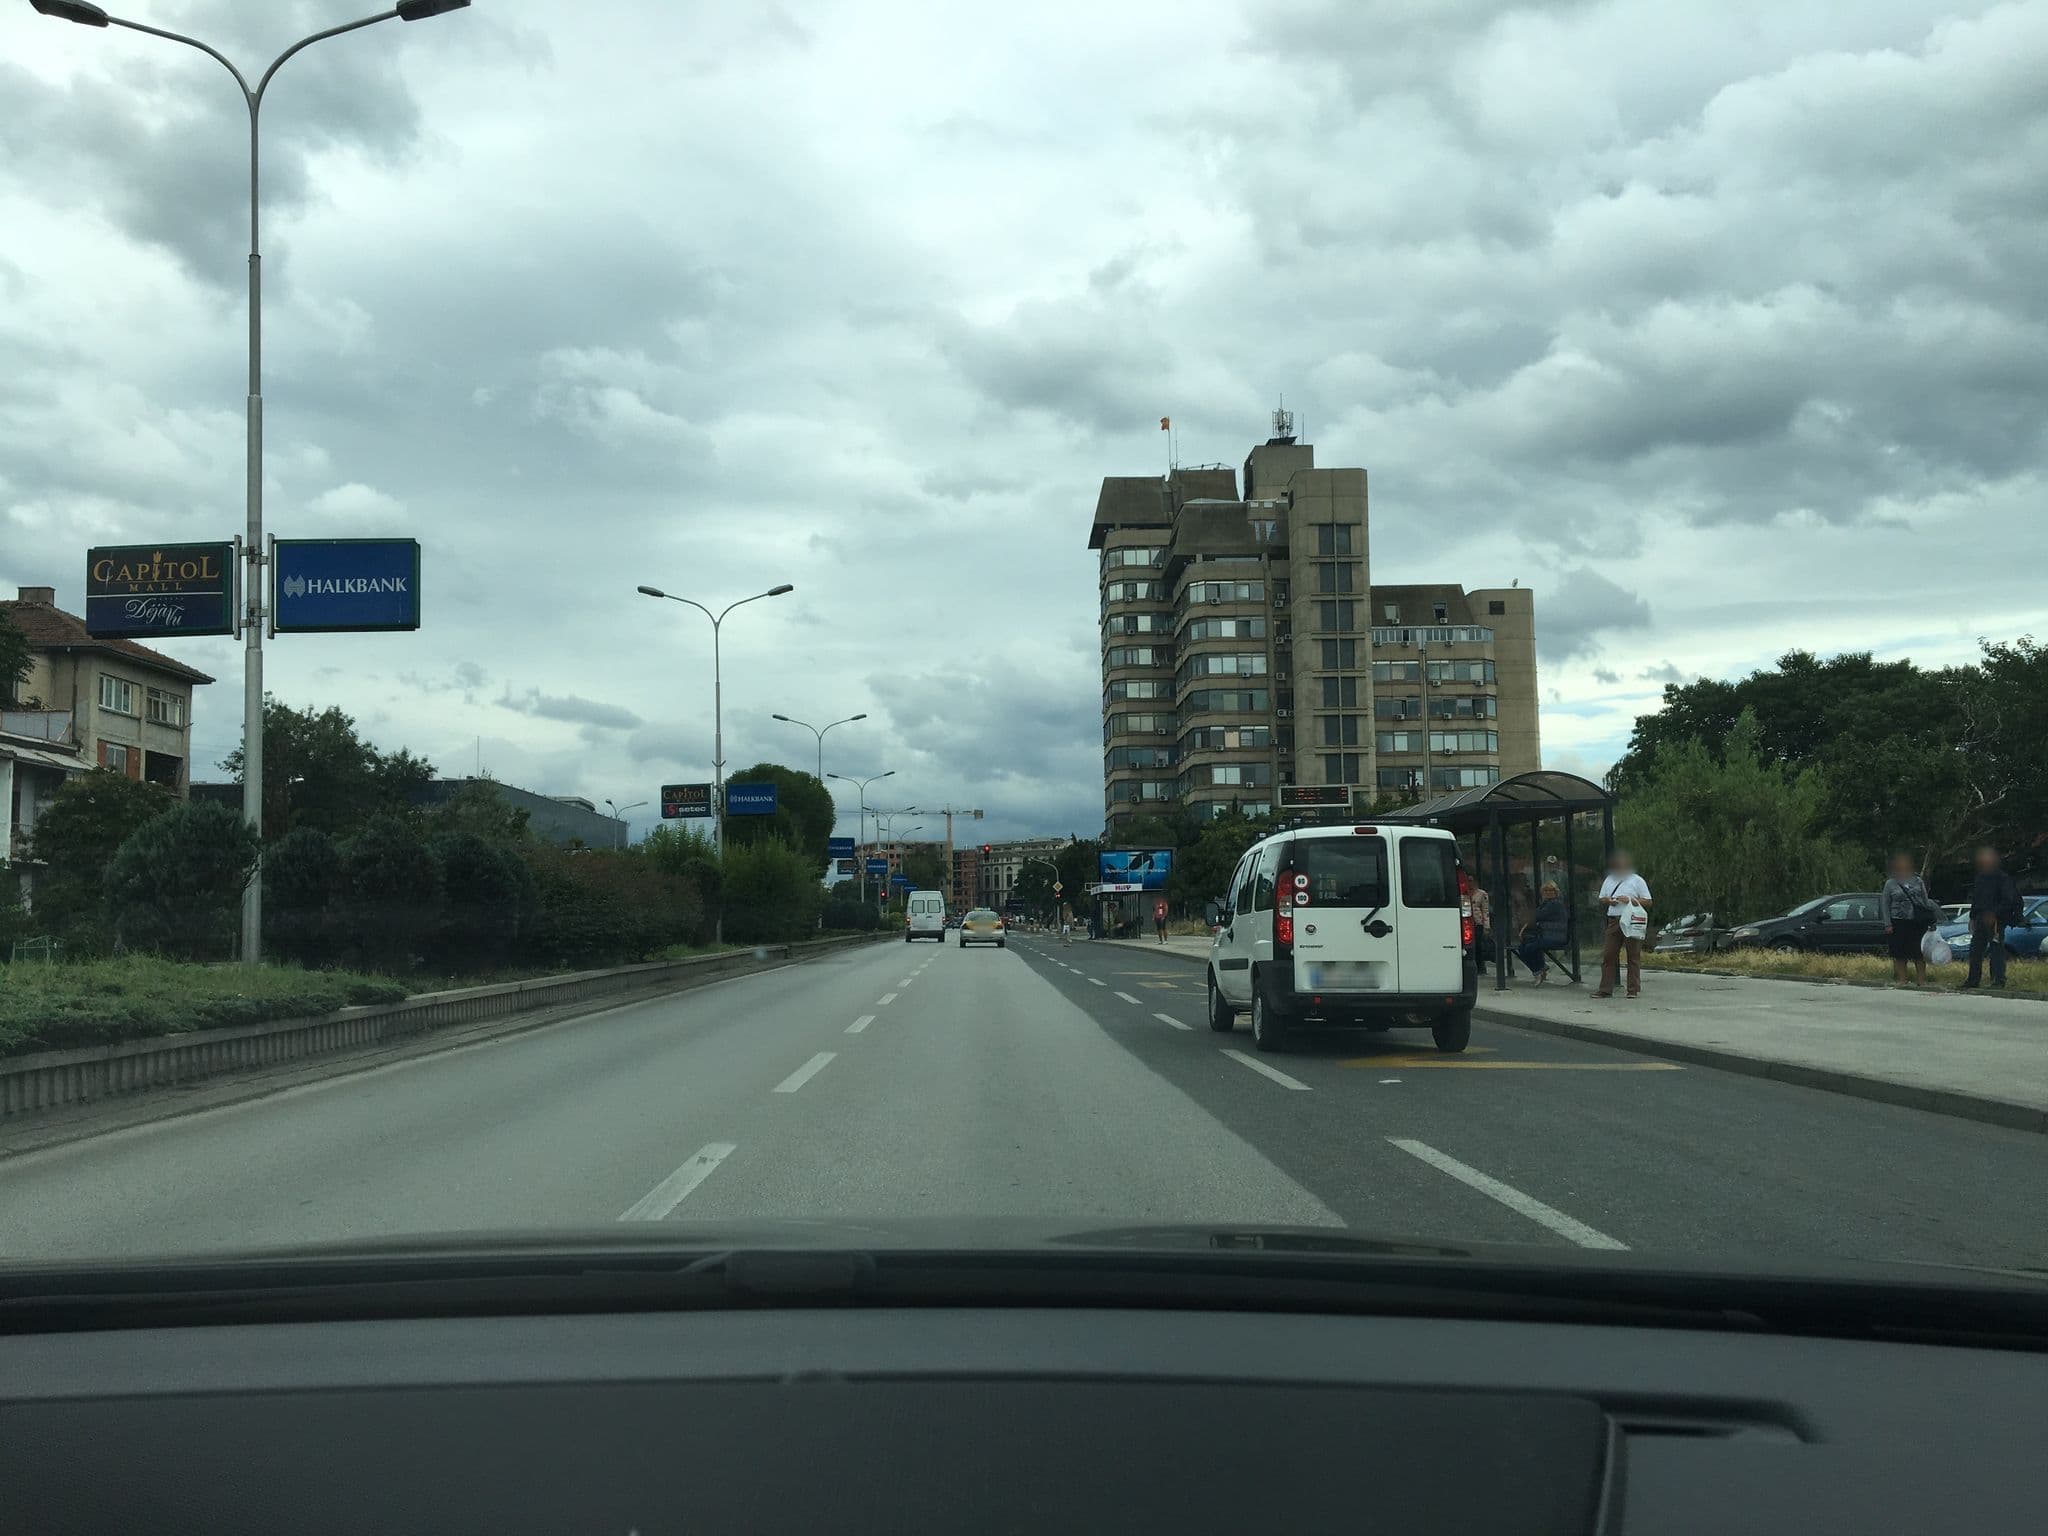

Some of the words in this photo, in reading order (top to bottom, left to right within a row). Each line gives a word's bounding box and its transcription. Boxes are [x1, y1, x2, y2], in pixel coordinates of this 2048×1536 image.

[93, 551, 219, 582] CAPITOL
[129, 582, 183, 592] MALL
[308, 577, 407, 594] HALKBANK
